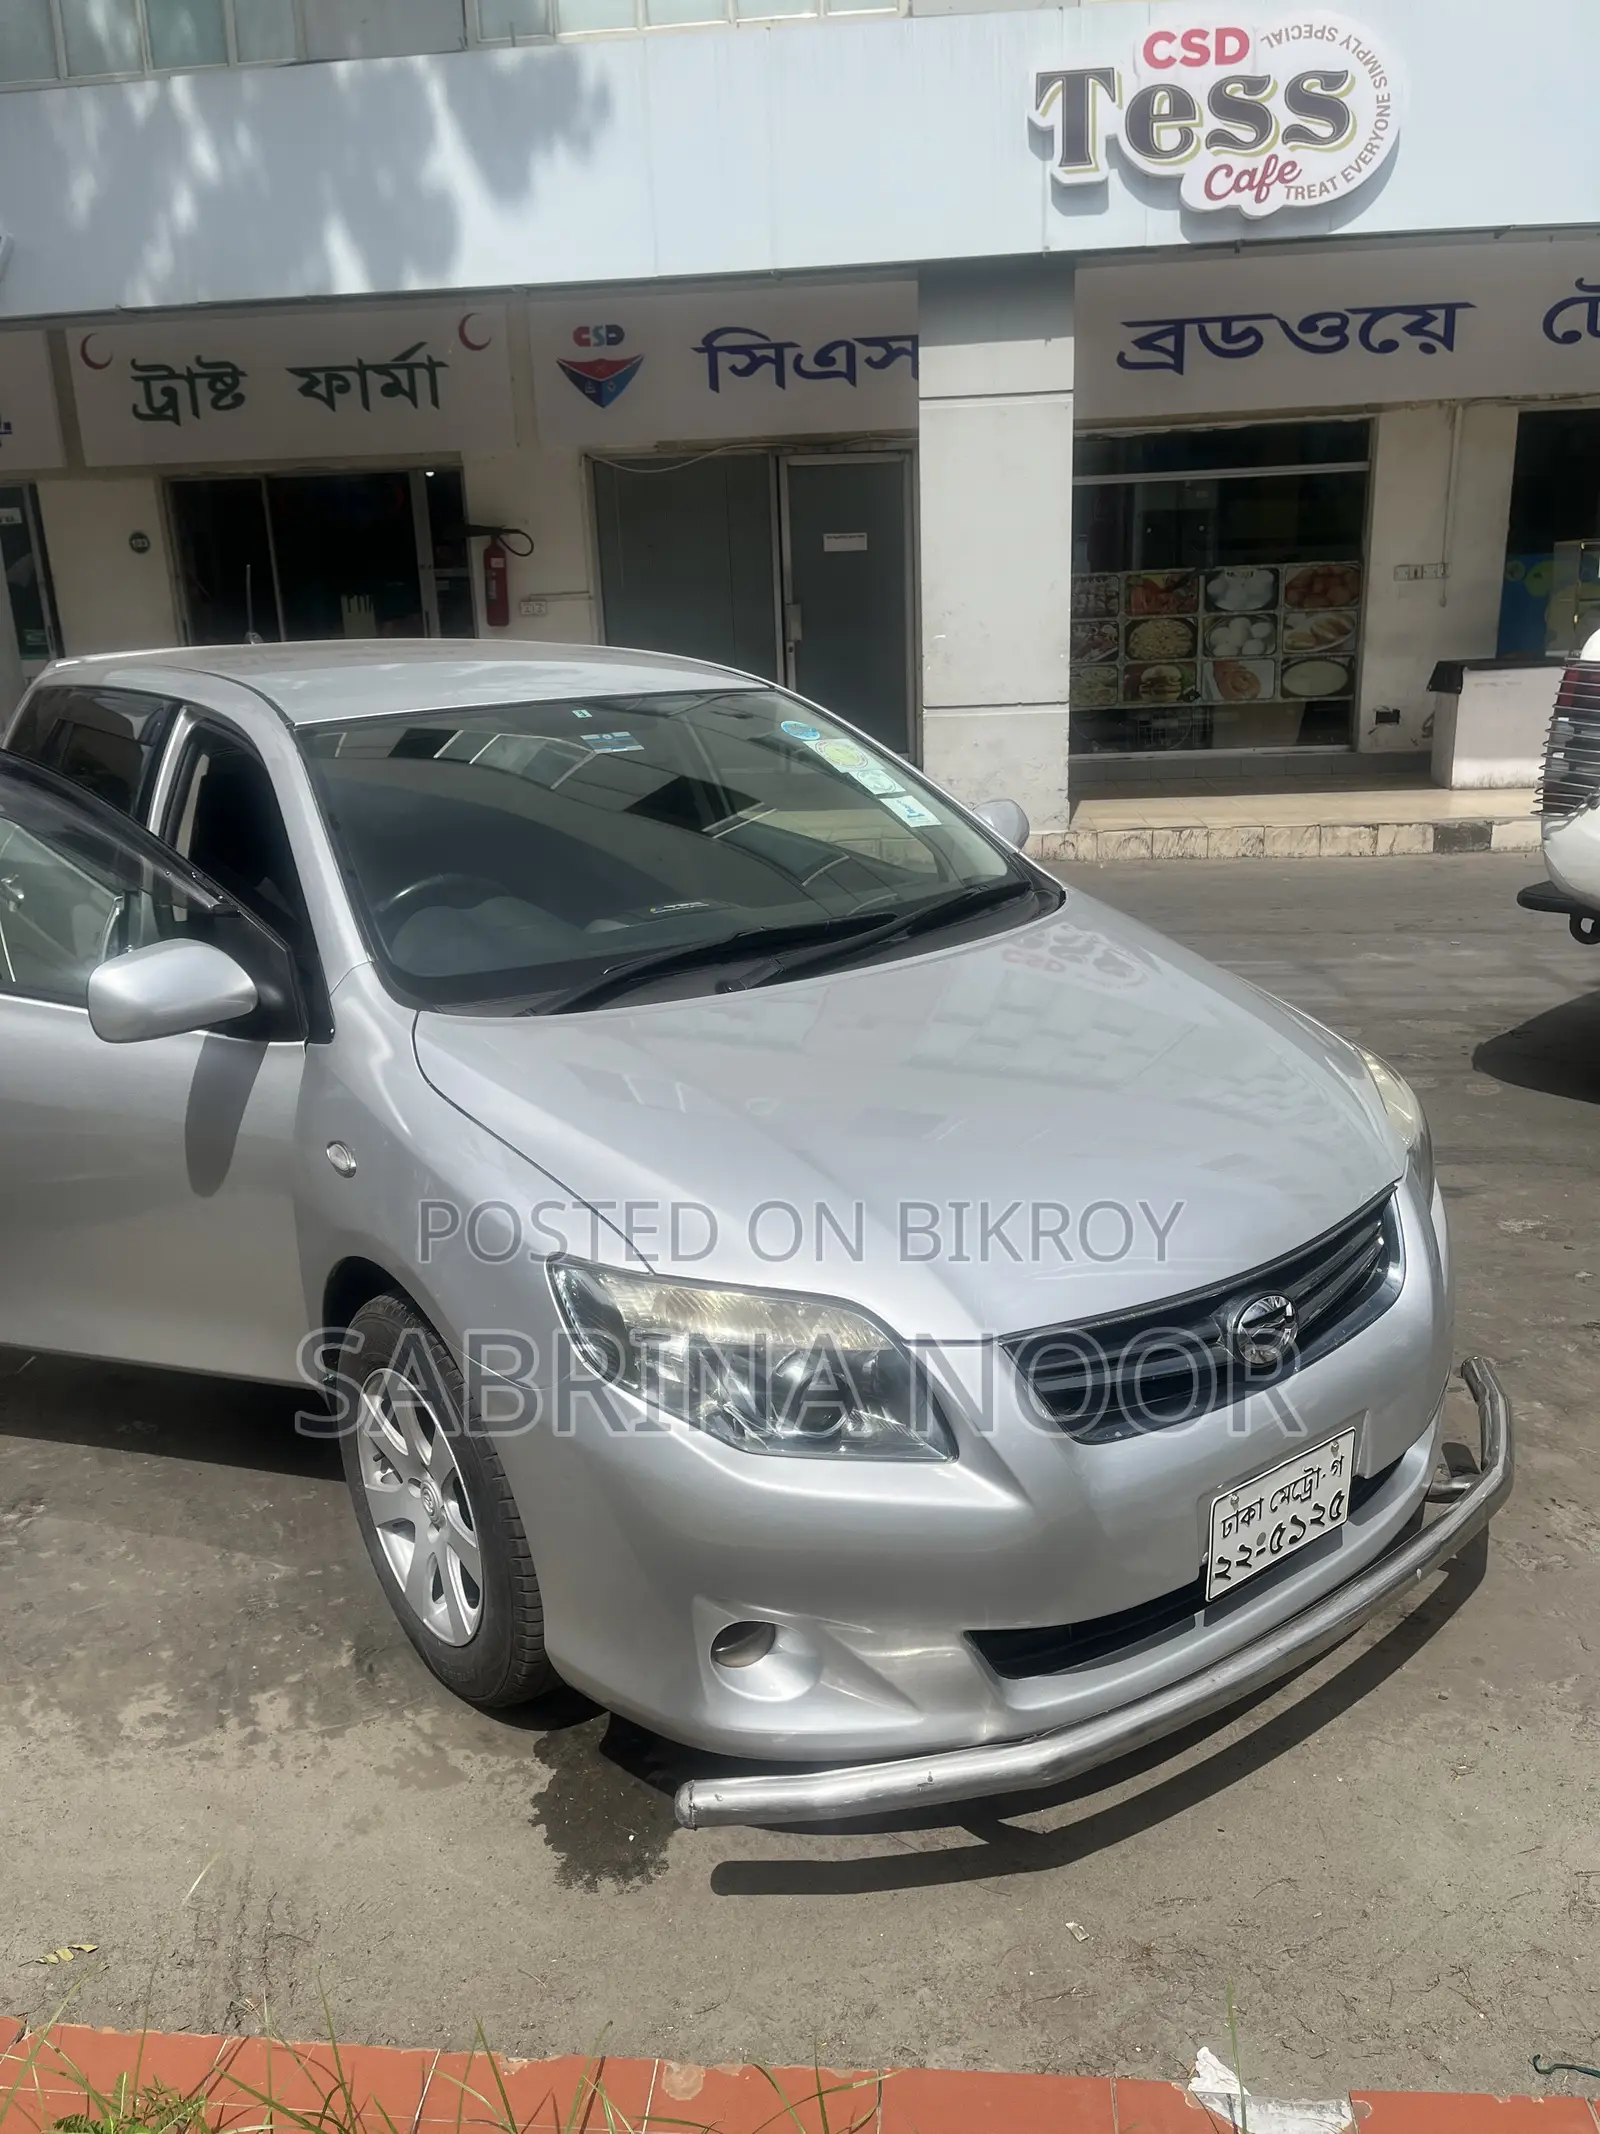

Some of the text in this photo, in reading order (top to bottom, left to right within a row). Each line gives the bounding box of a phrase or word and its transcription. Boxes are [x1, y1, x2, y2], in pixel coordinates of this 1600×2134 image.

[1143, 27, 1250, 69] CSD
[1035, 67, 1354, 168] Tess
[1260, 24, 1391, 201] TREAT EVERYONE SIMPLY SPECIAL
[1204, 154, 1302, 204] Cafe
[572, 323, 625, 347] CSD
[1116, 302, 1477, 375] ব্রডওয়ে
[286, 342, 449, 411] ফার্মা
[1214, 1489, 1346, 1581] ২২-৫১২৫
[1221, 1497, 1264, 1539] ঢাকা
